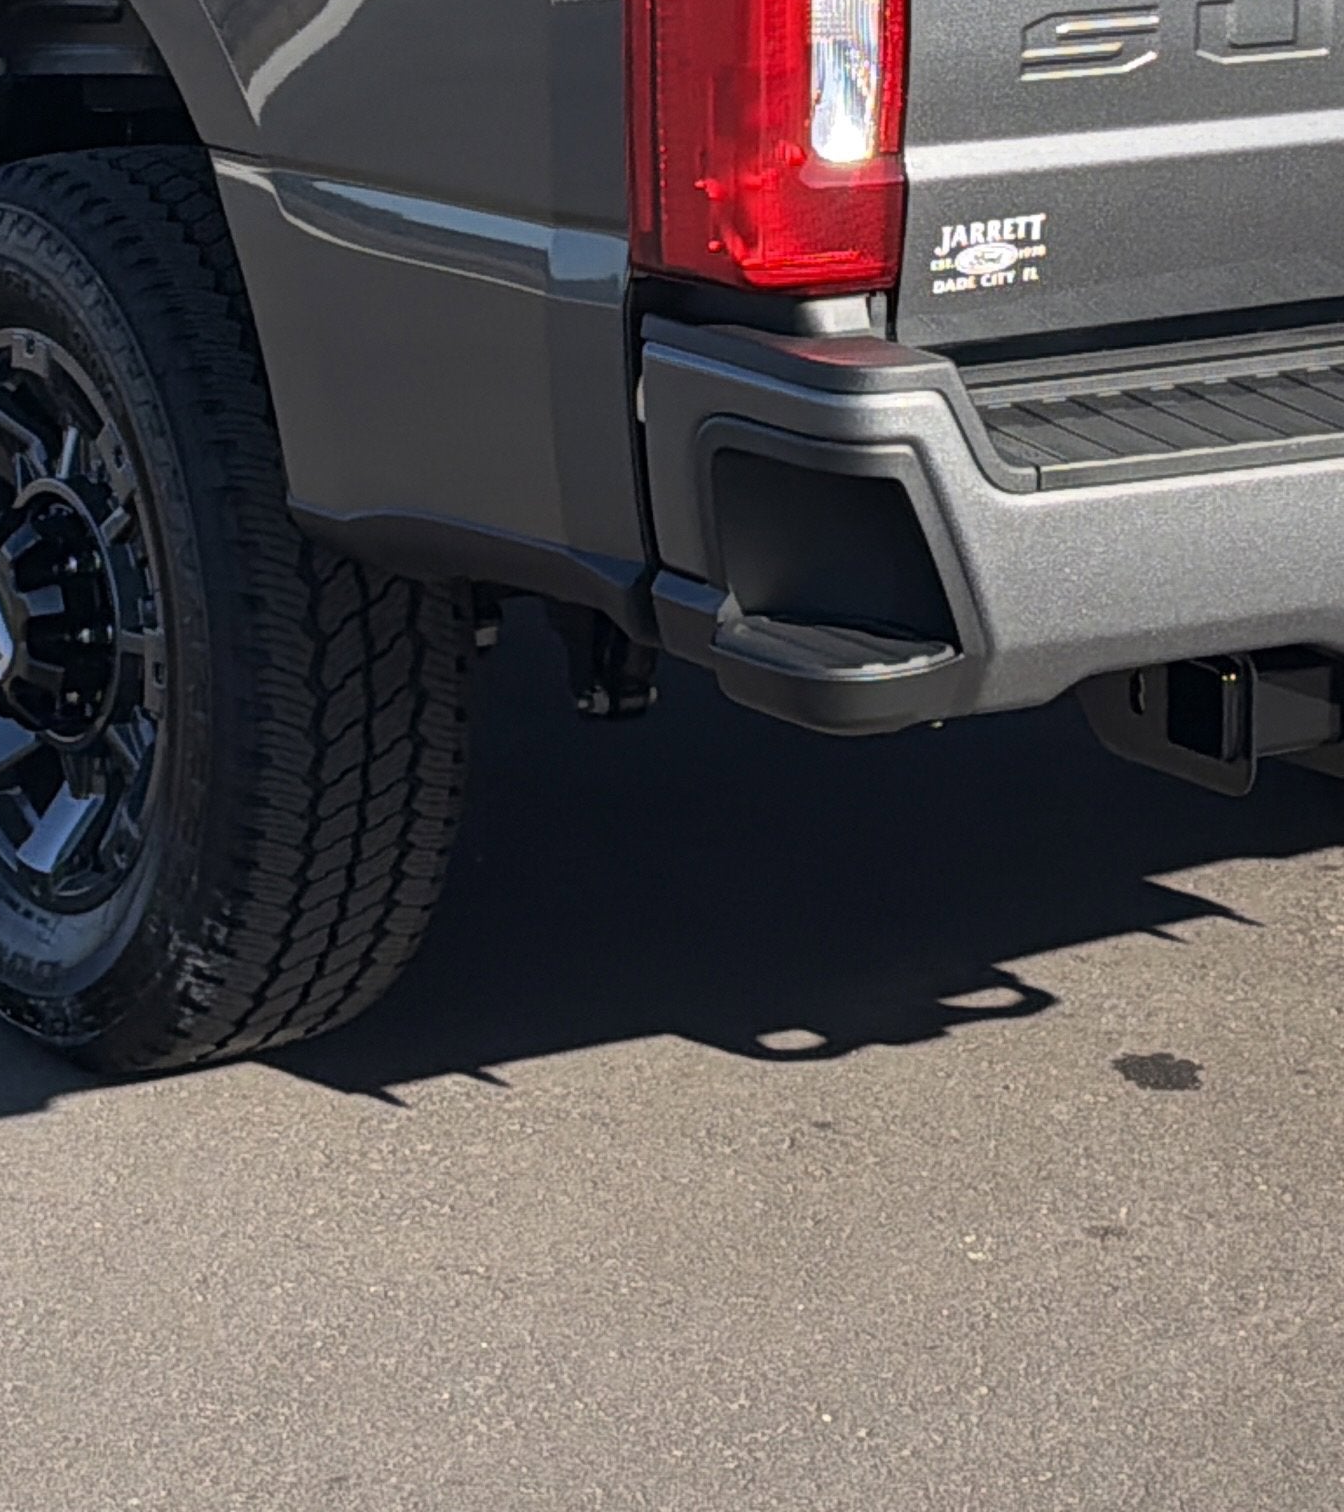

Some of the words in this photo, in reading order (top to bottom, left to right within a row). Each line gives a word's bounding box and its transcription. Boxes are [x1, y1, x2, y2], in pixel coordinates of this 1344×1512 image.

[933, 213, 1047, 257] JARRETT
[932, 276, 976, 294] DADE
[980, 270, 1017, 288] CITY
